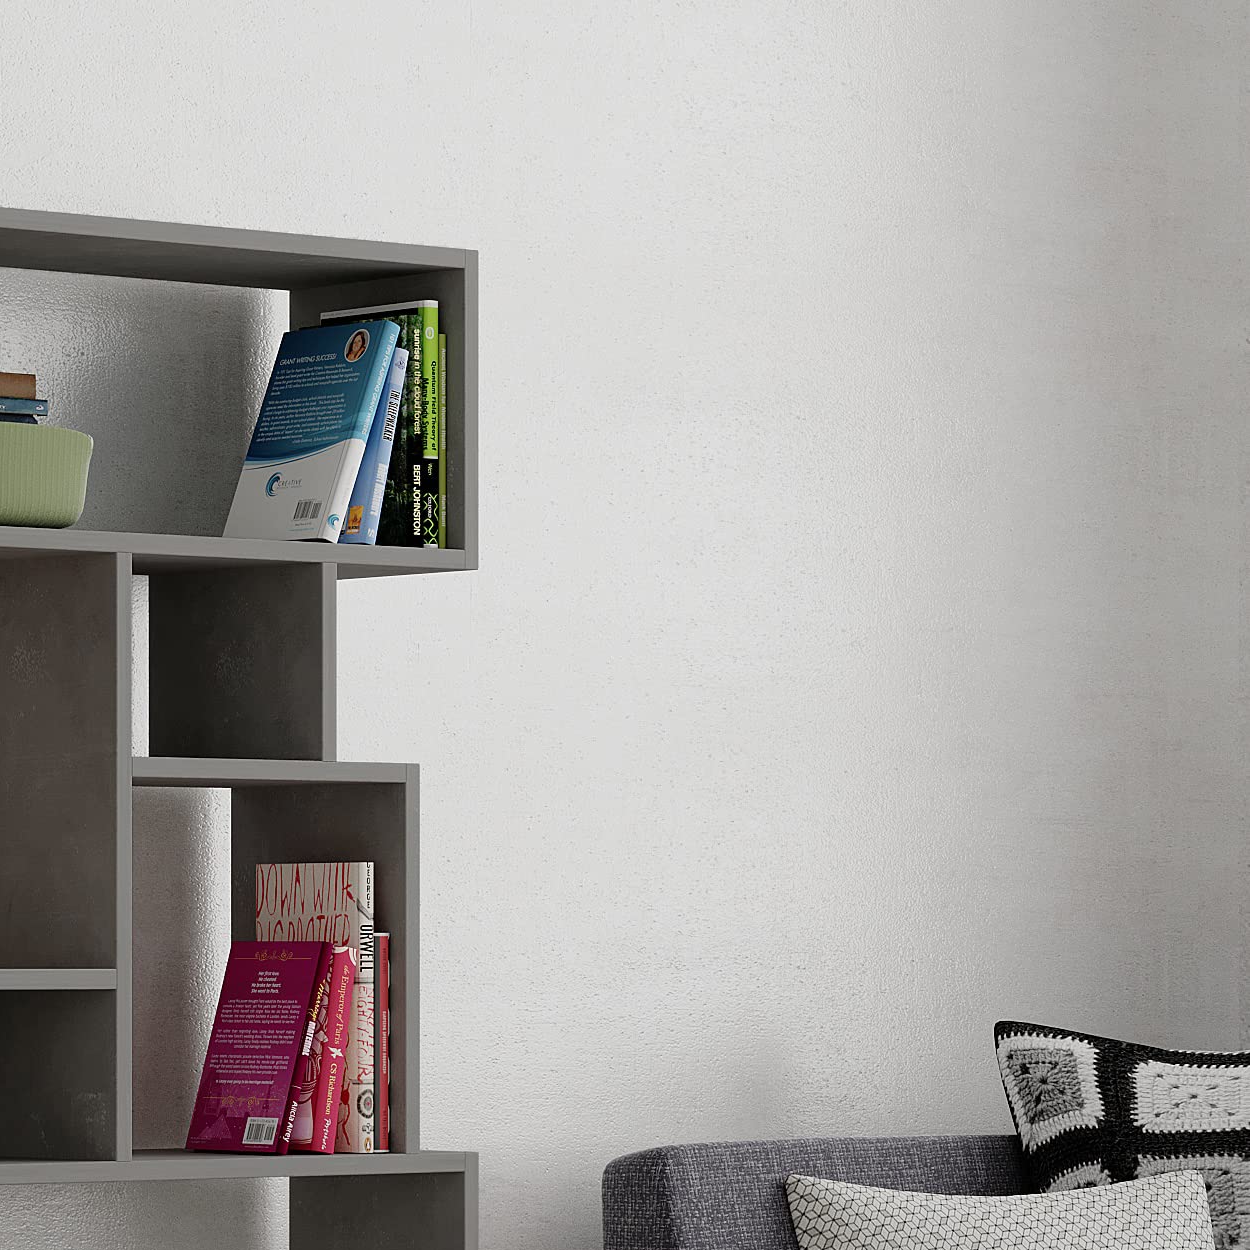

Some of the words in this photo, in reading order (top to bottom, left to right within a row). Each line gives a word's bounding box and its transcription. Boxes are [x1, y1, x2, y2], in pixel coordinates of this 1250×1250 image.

[414, 361, 421, 369] in
[391, 390, 400, 400] THE
[383, 402, 399, 441] SLEEPWALKER
[432, 441, 436, 450] of
[255, 863, 307, 919] DOWN
[359, 924, 374, 973] ORWELL
[338, 975, 349, 1014] Emperor
[335, 1023, 344, 1044] Paris
[330, 1063, 338, 1074] CS
[325, 1075, 336, 1115] Richardson
